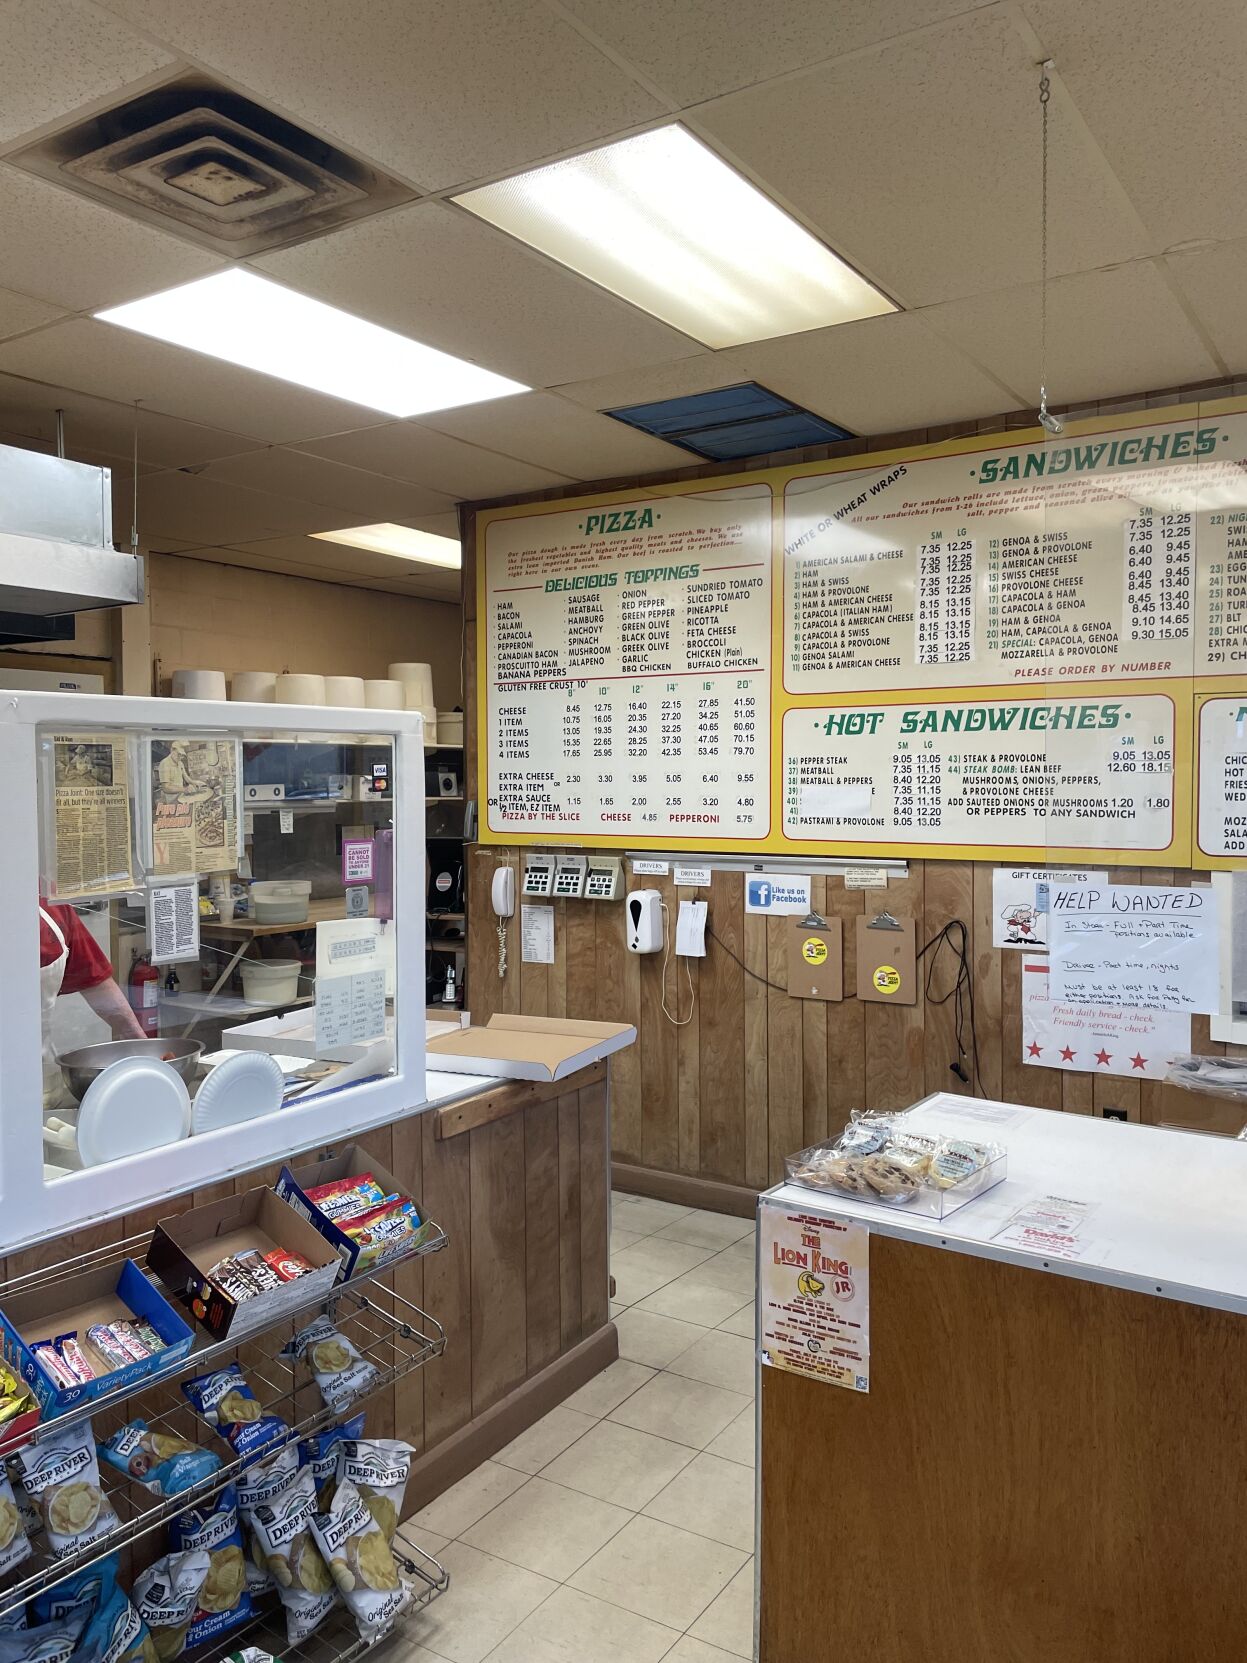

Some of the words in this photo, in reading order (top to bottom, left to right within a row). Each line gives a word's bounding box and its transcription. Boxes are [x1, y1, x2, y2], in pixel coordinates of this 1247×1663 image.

[979, 428, 1220, 484] SANDWICHES
[921, 496, 960, 507] sandwich
[963, 493, 983, 502] rolls
[784, 530, 816, 556] WHITE
[818, 518, 832, 532] OR
[834, 493, 868, 521] WHEAT
[870, 466, 908, 495] WRAPS
[585, 508, 653, 535] PIZZA
[1002, 537, 1030, 546] GENOA
[1034, 536, 1039, 544] &
[1043, 532, 1068, 542] SWISS
[803, 559, 838, 568] AMERICAN
[870, 553, 874, 561] &
[878, 550, 903, 560] CHEESE
[921, 545, 941, 554] 7.35
[947, 541, 972, 551] 12.25
[545, 573, 618, 592] DELICIOUS
[624, 564, 700, 584] TOPPINGS
[1002, 571, 1026, 580] SWISS
[1030, 568, 1059, 578] CHEESE
[688, 582, 725, 593] SUNDRIED
[730, 578, 763, 589] TOMATO
[569, 594, 600, 604] SAUSAGE
[622, 590, 646, 598] ONION
[498, 602, 513, 610] HAM
[569, 605, 603, 614] MEATBALL
[638, 599, 664, 608] PEPPER
[687, 604, 728, 615] PINEAPPLE
[498, 612, 520, 620] BACON
[802, 610, 838, 619] CAPACOLA
[841, 607, 869, 617] (ITALIAN
[872, 605, 892, 613] HAM)
[569, 615, 604, 624] HAMBURG
[687, 616, 718, 626] RICOTTA
[1132, 616, 1155, 626] 9.10
[1160, 615, 1189, 624] 14.65
[498, 622, 522, 630] SALAMI
[687, 629, 704, 637] FETA
[708, 626, 736, 635] CHEESE
[622, 633, 645, 641] BLACK
[648, 631, 669, 640] OLIVE
[1131, 630, 1154, 639] 9.30
[1159, 628, 1188, 638] 15.05
[498, 642, 533, 650] PEPPERONI
[569, 637, 598, 645] SPINACH
[1002, 639, 1035, 648] SPECIAL:
[1039, 636, 1085, 646] CAPACOLA,
[1089, 634, 1118, 642] GENOA
[498, 652, 532, 660] CANADIAN
[536, 650, 558, 658] BACON
[569, 647, 611, 656] MUSHROOM
[686, 650, 721, 658] CHICKEN
[725, 647, 742, 657] (Plain)
[622, 655, 648, 663] GARLIC
[498, 671, 530, 679] BANANA
[534, 668, 566, 677] PEPPERS
[640, 664, 671, 672] CHICKEN
[1015, 668, 1053, 677] PLEASE
[1059, 666, 1095, 674] ORDER
[1102, 664, 1115, 672] BY
[1122, 662, 1171, 672] NUMBER
[498, 684, 526, 692] GLUTEN
[550, 681, 573, 689] CRUST
[499, 707, 526, 715] CHEESE
[628, 702, 647, 710] 16.40
[662, 701, 681, 709] 22.15
[734, 698, 755, 706] 41.50
[823, 712, 884, 735] HOT
[900, 704, 1123, 734] SANDWICHES
[893, 755, 912, 763] 9.05
[917, 755, 940, 763] 13.05
[999, 754, 1046, 762] PROVOLONE
[1021, 765, 1040, 773] LEAN
[1044, 765, 1061, 773] BEEF
[601, 814, 631, 822] CHEESE
[670, 815, 720, 823] PEPPERONI
[737, 815, 752, 823] 5.75
[1051, 809, 1072, 817] ANY
[1076, 809, 1135, 818] SANDWICH
[772, 895, 806, 903] Facebook
[1054, 891, 1100, 909] HELP
[1112, 892, 1203, 912] WANTED
[1052, 1006, 1073, 1016] Fresh
[1076, 1008, 1096, 1018] daily
[1099, 1009, 1122, 1020] bread
[1053, 1017, 1085, 1028] Friendly
[1088, 1022, 1117, 1031] service
[328, 1204, 360, 1218] GUMMIES
[801, 1234, 820, 1247] THE
[774, 1242, 807, 1266] LION
[812, 1250, 848, 1275] KING
[835, 1281, 850, 1294] JR
[343, 1372, 355, 1381] Salt
[65, 1390, 80, 1402] 30
[96, 1371, 128, 1391] Variety
[128, 1364, 151, 1378] Pack
[202, 1384, 223, 1404] DEEP
[245, 1423, 261, 1434] Cream
[242, 1432, 259, 1444] Onion
[24, 1471, 54, 1491] DEEP
[56, 1452, 89, 1475] RIVER
[349, 1465, 375, 1478] DEEP
[375, 1468, 405, 1481] RIVER
[272, 1516, 300, 1540] DEEP
[329, 1517, 353, 1543] DEEP
[183, 1530, 213, 1550] DEEP
[368, 1593, 393, 1622] Original
[204, 1610, 231, 1626] Cream
[195, 1622, 222, 1639] Onion
